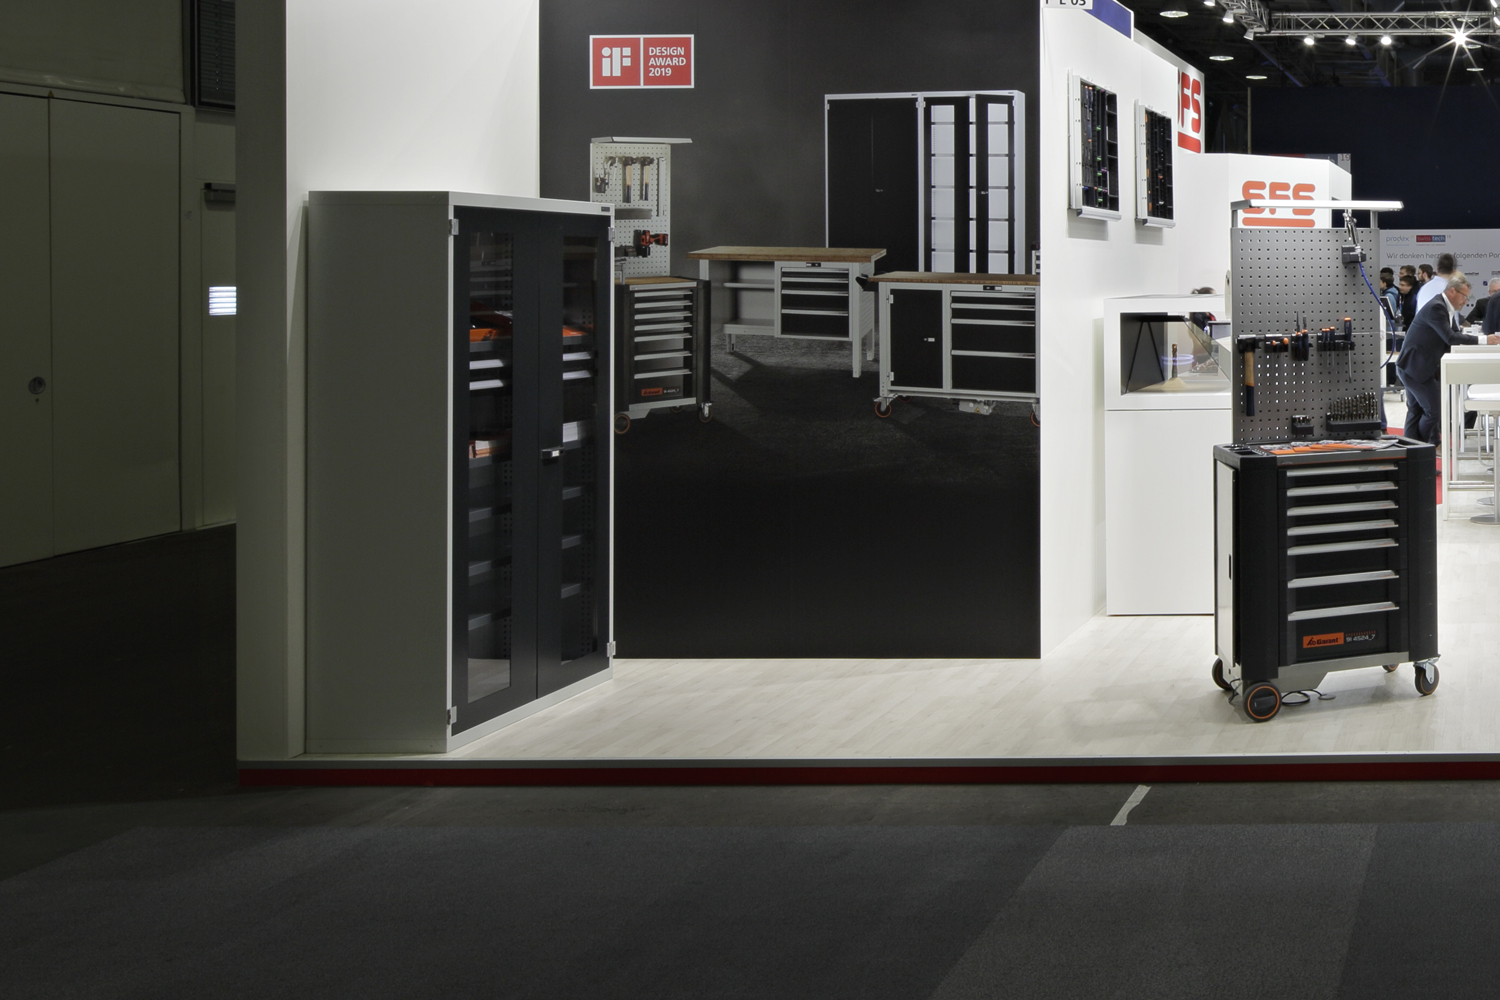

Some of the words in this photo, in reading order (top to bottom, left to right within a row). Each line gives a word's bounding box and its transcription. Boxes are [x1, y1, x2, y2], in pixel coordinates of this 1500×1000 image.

[648, 47, 685, 56] DESIGN
[648, 57, 687, 66] AWARD
[648, 67, 672, 77] 2019
[1178, 69, 1202, 134] FS
[1242, 181, 1316, 216] SFS
[1454, 252, 1487, 260] folgenden
[1316, 637, 1338, 645] Garant
